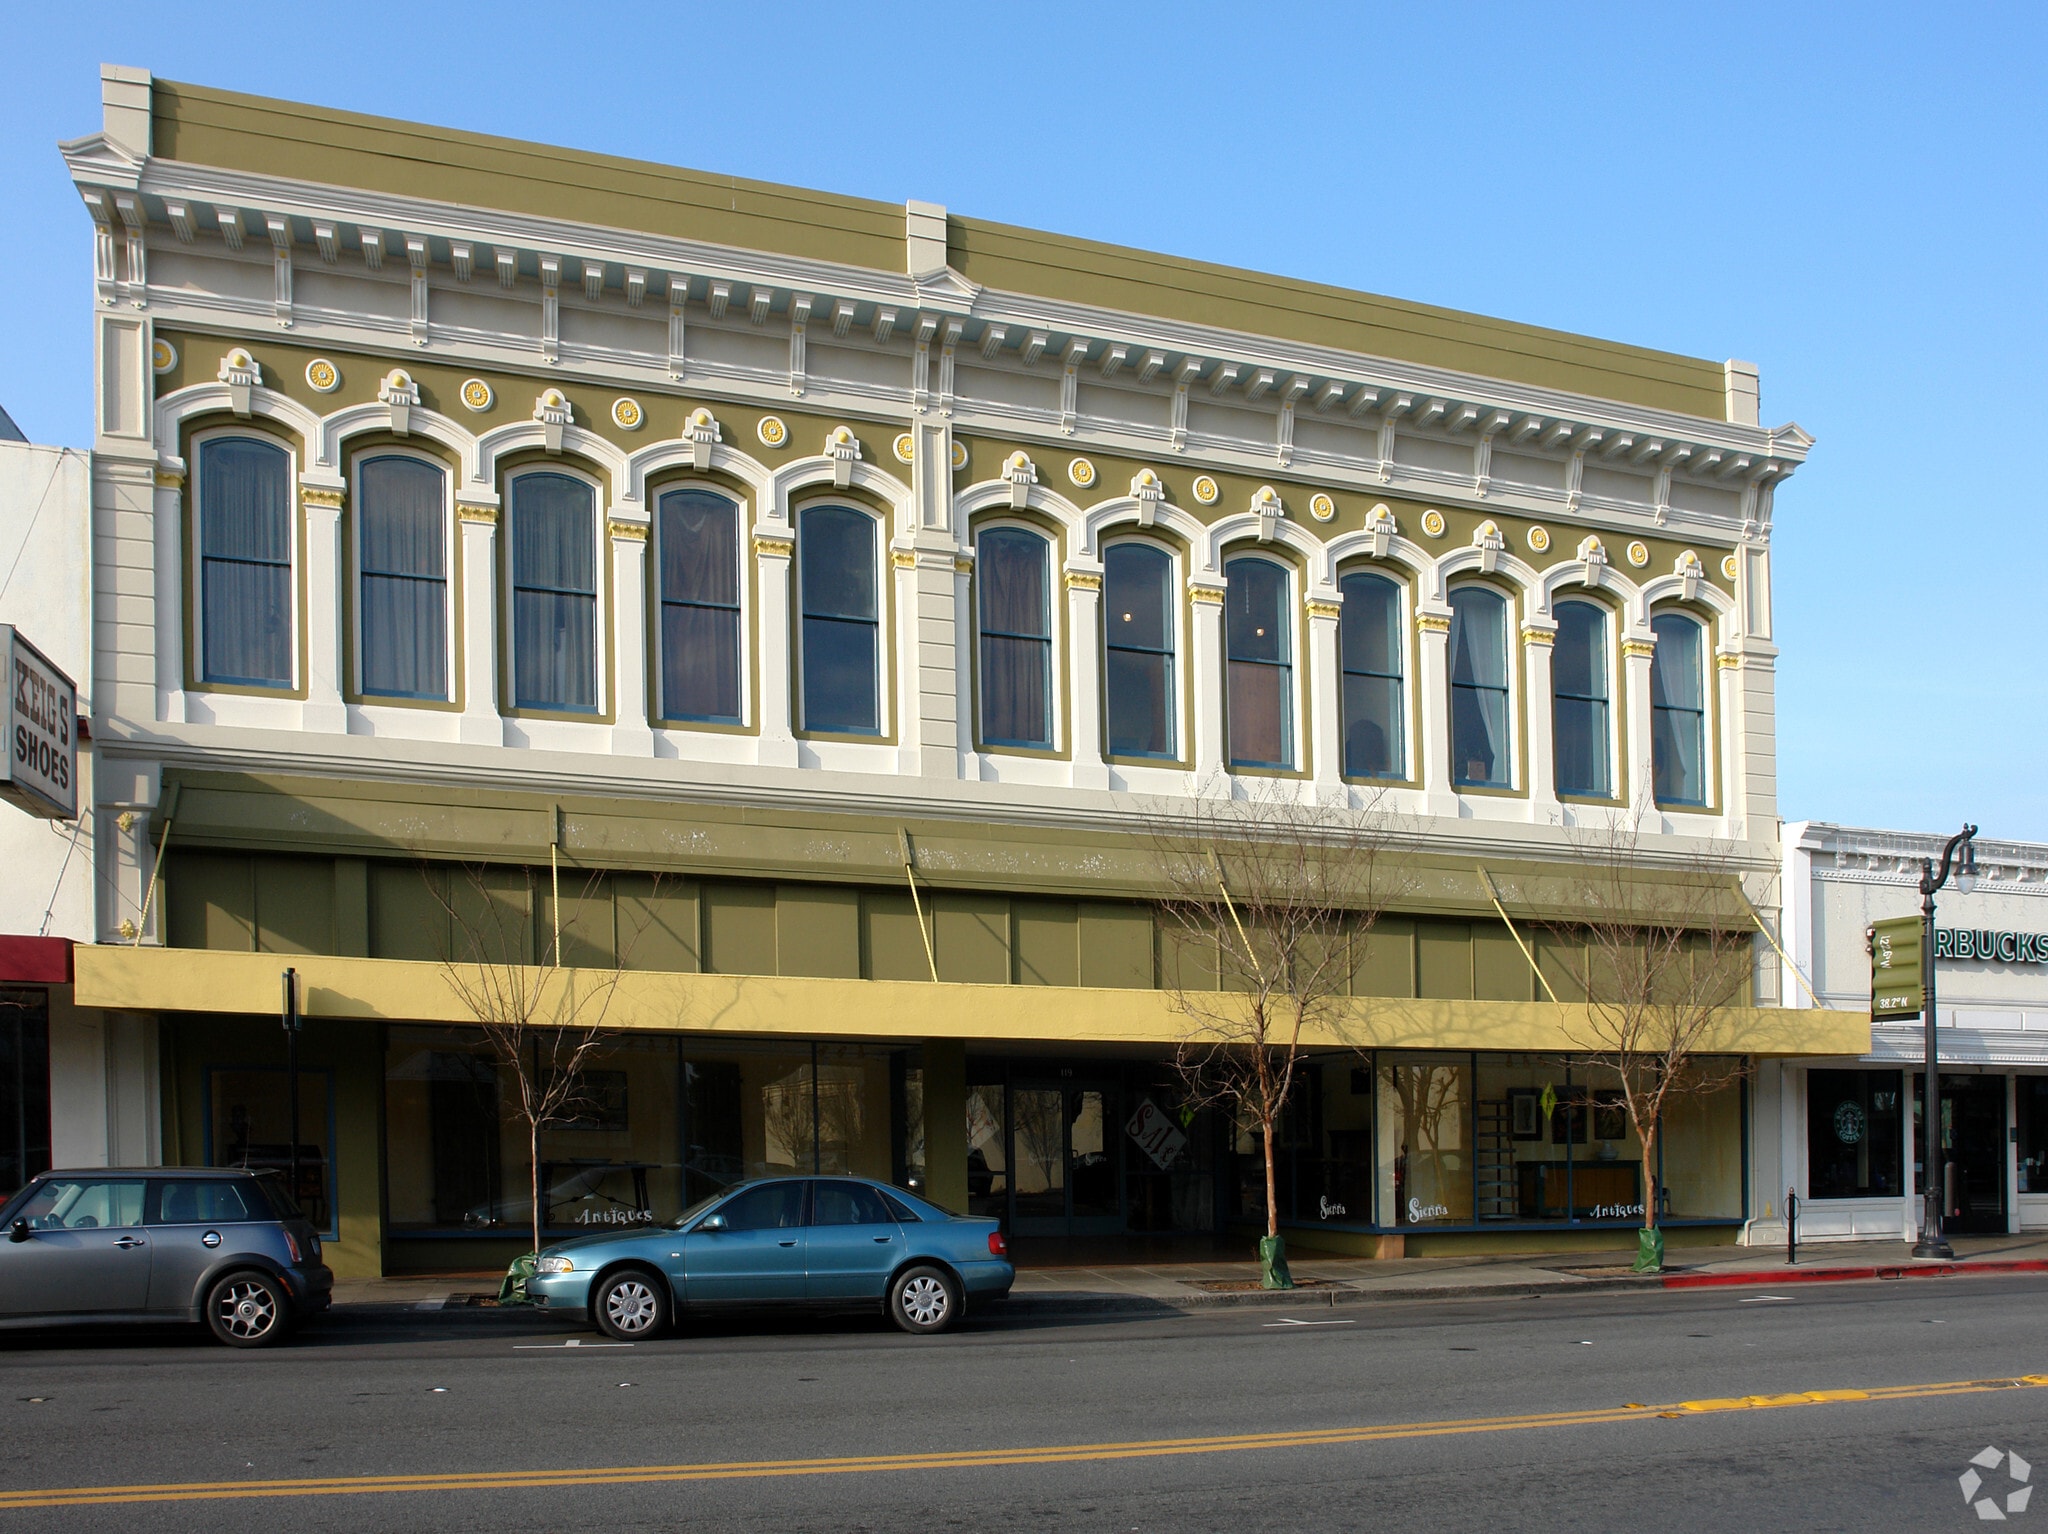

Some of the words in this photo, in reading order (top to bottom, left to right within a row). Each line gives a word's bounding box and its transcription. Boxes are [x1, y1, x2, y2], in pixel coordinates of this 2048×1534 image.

[15, 724, 69, 790] SHOES
[1934, 927, 2048, 964] RBUCKS
[1408, 1197, 1449, 1223] Sienna
